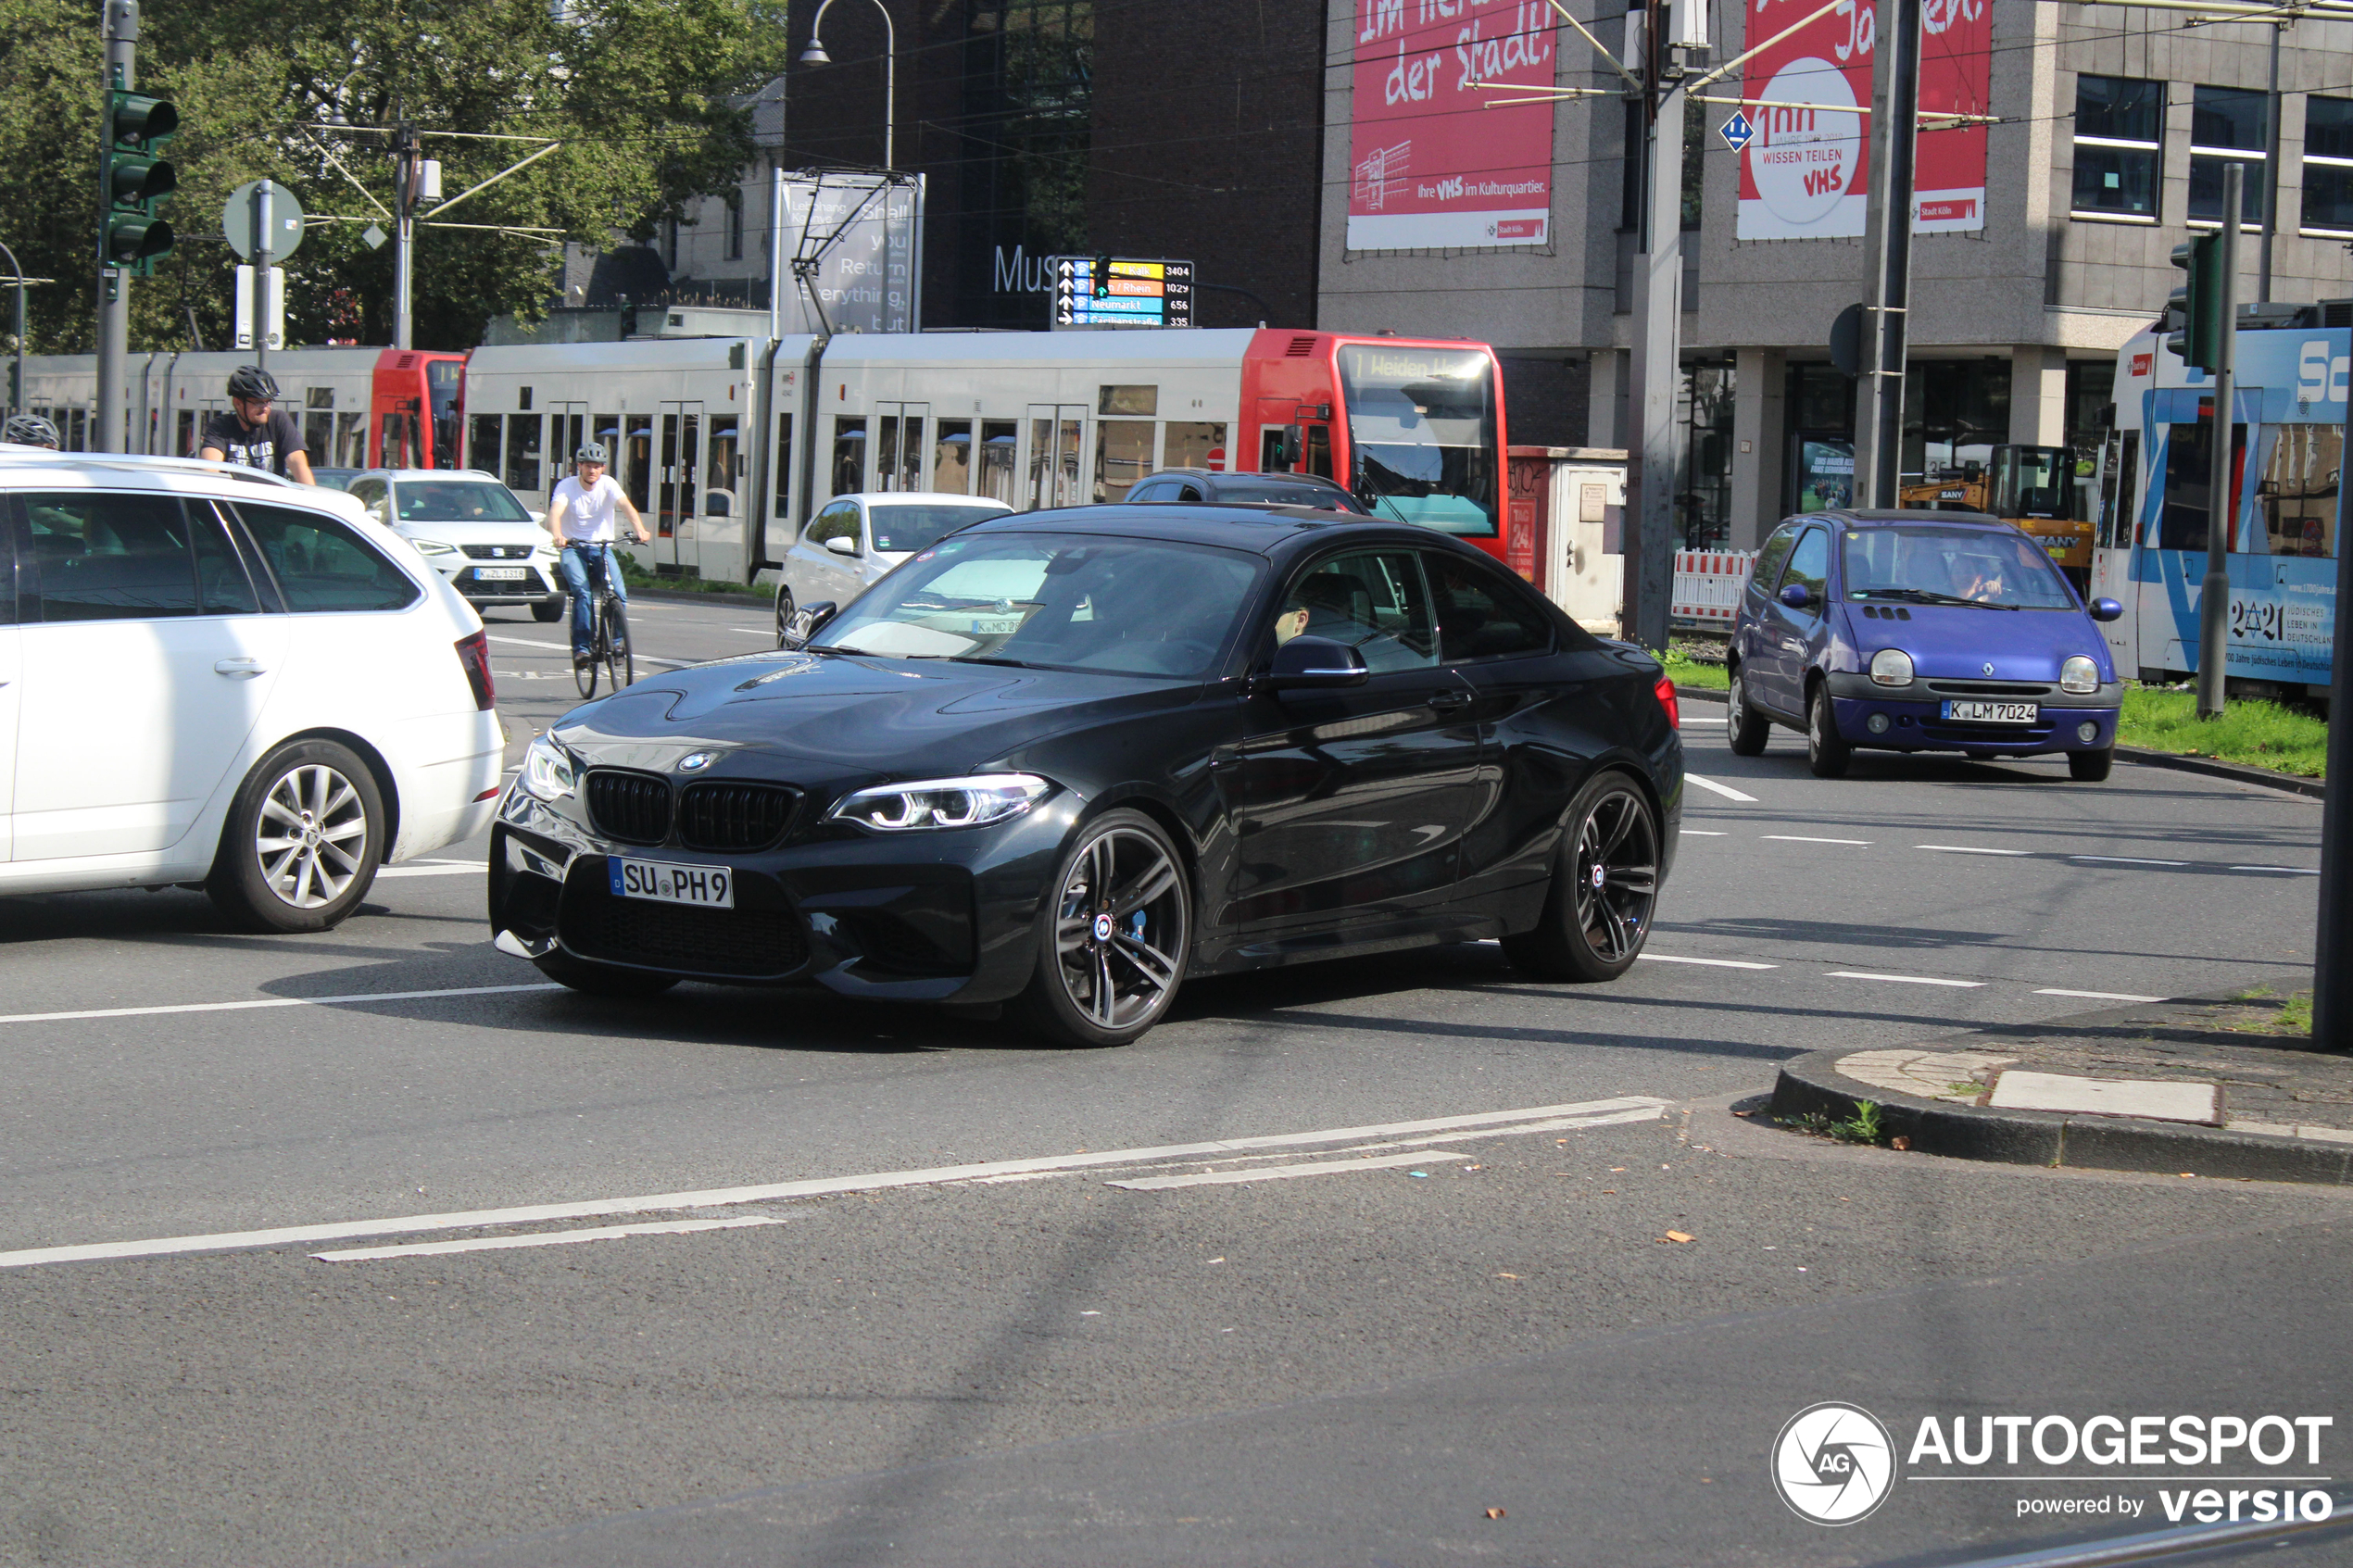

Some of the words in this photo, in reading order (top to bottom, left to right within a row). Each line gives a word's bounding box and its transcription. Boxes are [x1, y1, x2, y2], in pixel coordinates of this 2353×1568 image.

[1385, 38, 1441, 106] der
[1773, 135, 1802, 148] JAHRE
[1763, 151, 1803, 165] WISSEN
[1806, 149, 1843, 162] TEILEN
[1804, 163, 1843, 197] VHS
[1417, 183, 1435, 198] Ihre
[1437, 176, 1464, 201] VHS
[1465, 182, 1478, 196] im
[1478, 181, 1545, 197] Kulturquartier.
[862, 203, 908, 221] Shall
[1921, 207, 1937, 216] Stadt
[1938, 206, 1952, 215] Köln
[1498, 225, 1512, 233] Stadt
[1512, 224, 1524, 233] Köln
[1128, 266, 1151, 276] Kalk
[1165, 266, 1190, 277] 3404
[1123, 282, 1151, 294] Rhein
[1166, 282, 1189, 294] 1029
[1091, 299, 1141, 310] Neumarkt
[1170, 300, 1189, 310] 656
[1169, 317, 1189, 327] 335
[1370, 355, 1428, 379] Weiden
[1941, 490, 1963, 499] SANY
[1513, 508, 1529, 522] TAG
[1512, 523, 1529, 548] 24
[2033, 535, 2081, 549] SANY
[479, 570, 486, 578] K
[503, 570, 524, 579] 1318
[2287, 605, 2324, 618] JÜDISCHES
[978, 621, 986, 633] K
[2286, 620, 2308, 630] LEBEN
[2310, 621, 2318, 630] IN
[2235, 653, 2250, 664] Jahre
[2251, 654, 2276, 667] jüdisches
[2277, 658, 2295, 668] Leben
[2295, 659, 2302, 668] in
[1951, 702, 1962, 718] K
[1972, 703, 1993, 719] LM
[1997, 705, 2035, 721] 7024
[624, 863, 658, 896] SU
